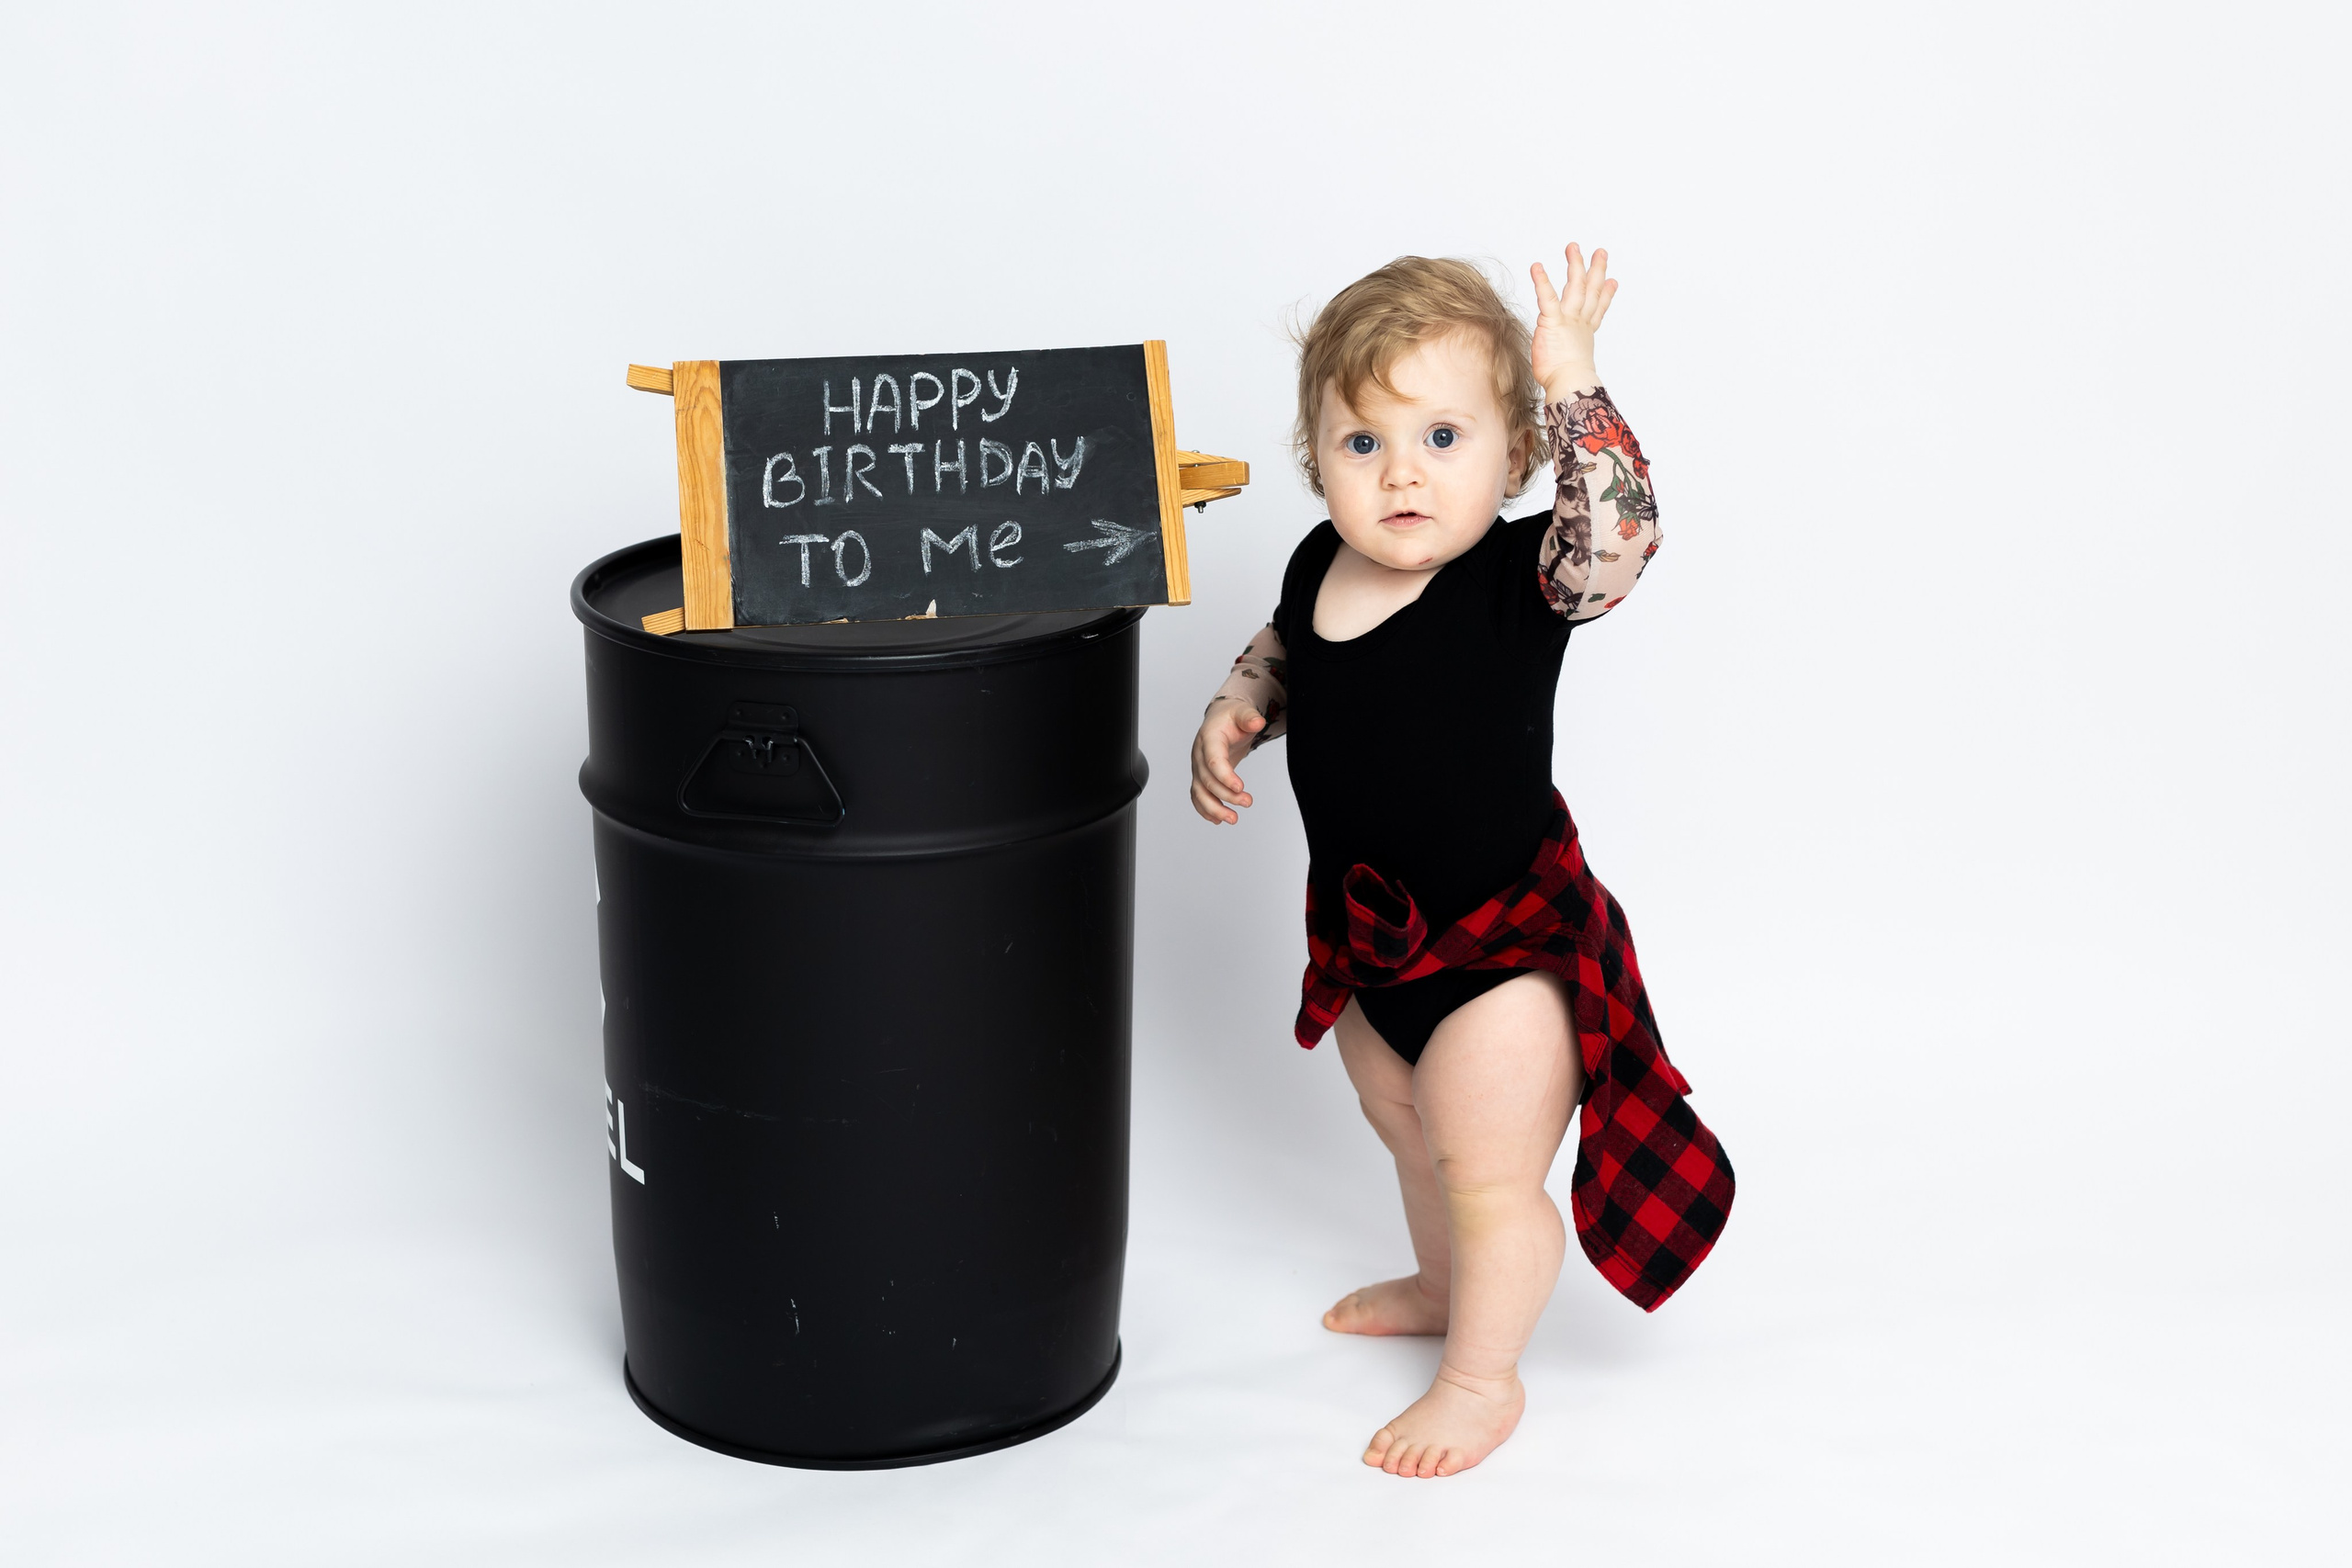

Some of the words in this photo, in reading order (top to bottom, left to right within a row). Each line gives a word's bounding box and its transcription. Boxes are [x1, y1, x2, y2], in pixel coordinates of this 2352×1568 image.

[822, 366, 1020, 436] HAPPY
[762, 434, 1087, 509] BIRTHDAY
[778, 528, 872, 588] TO
